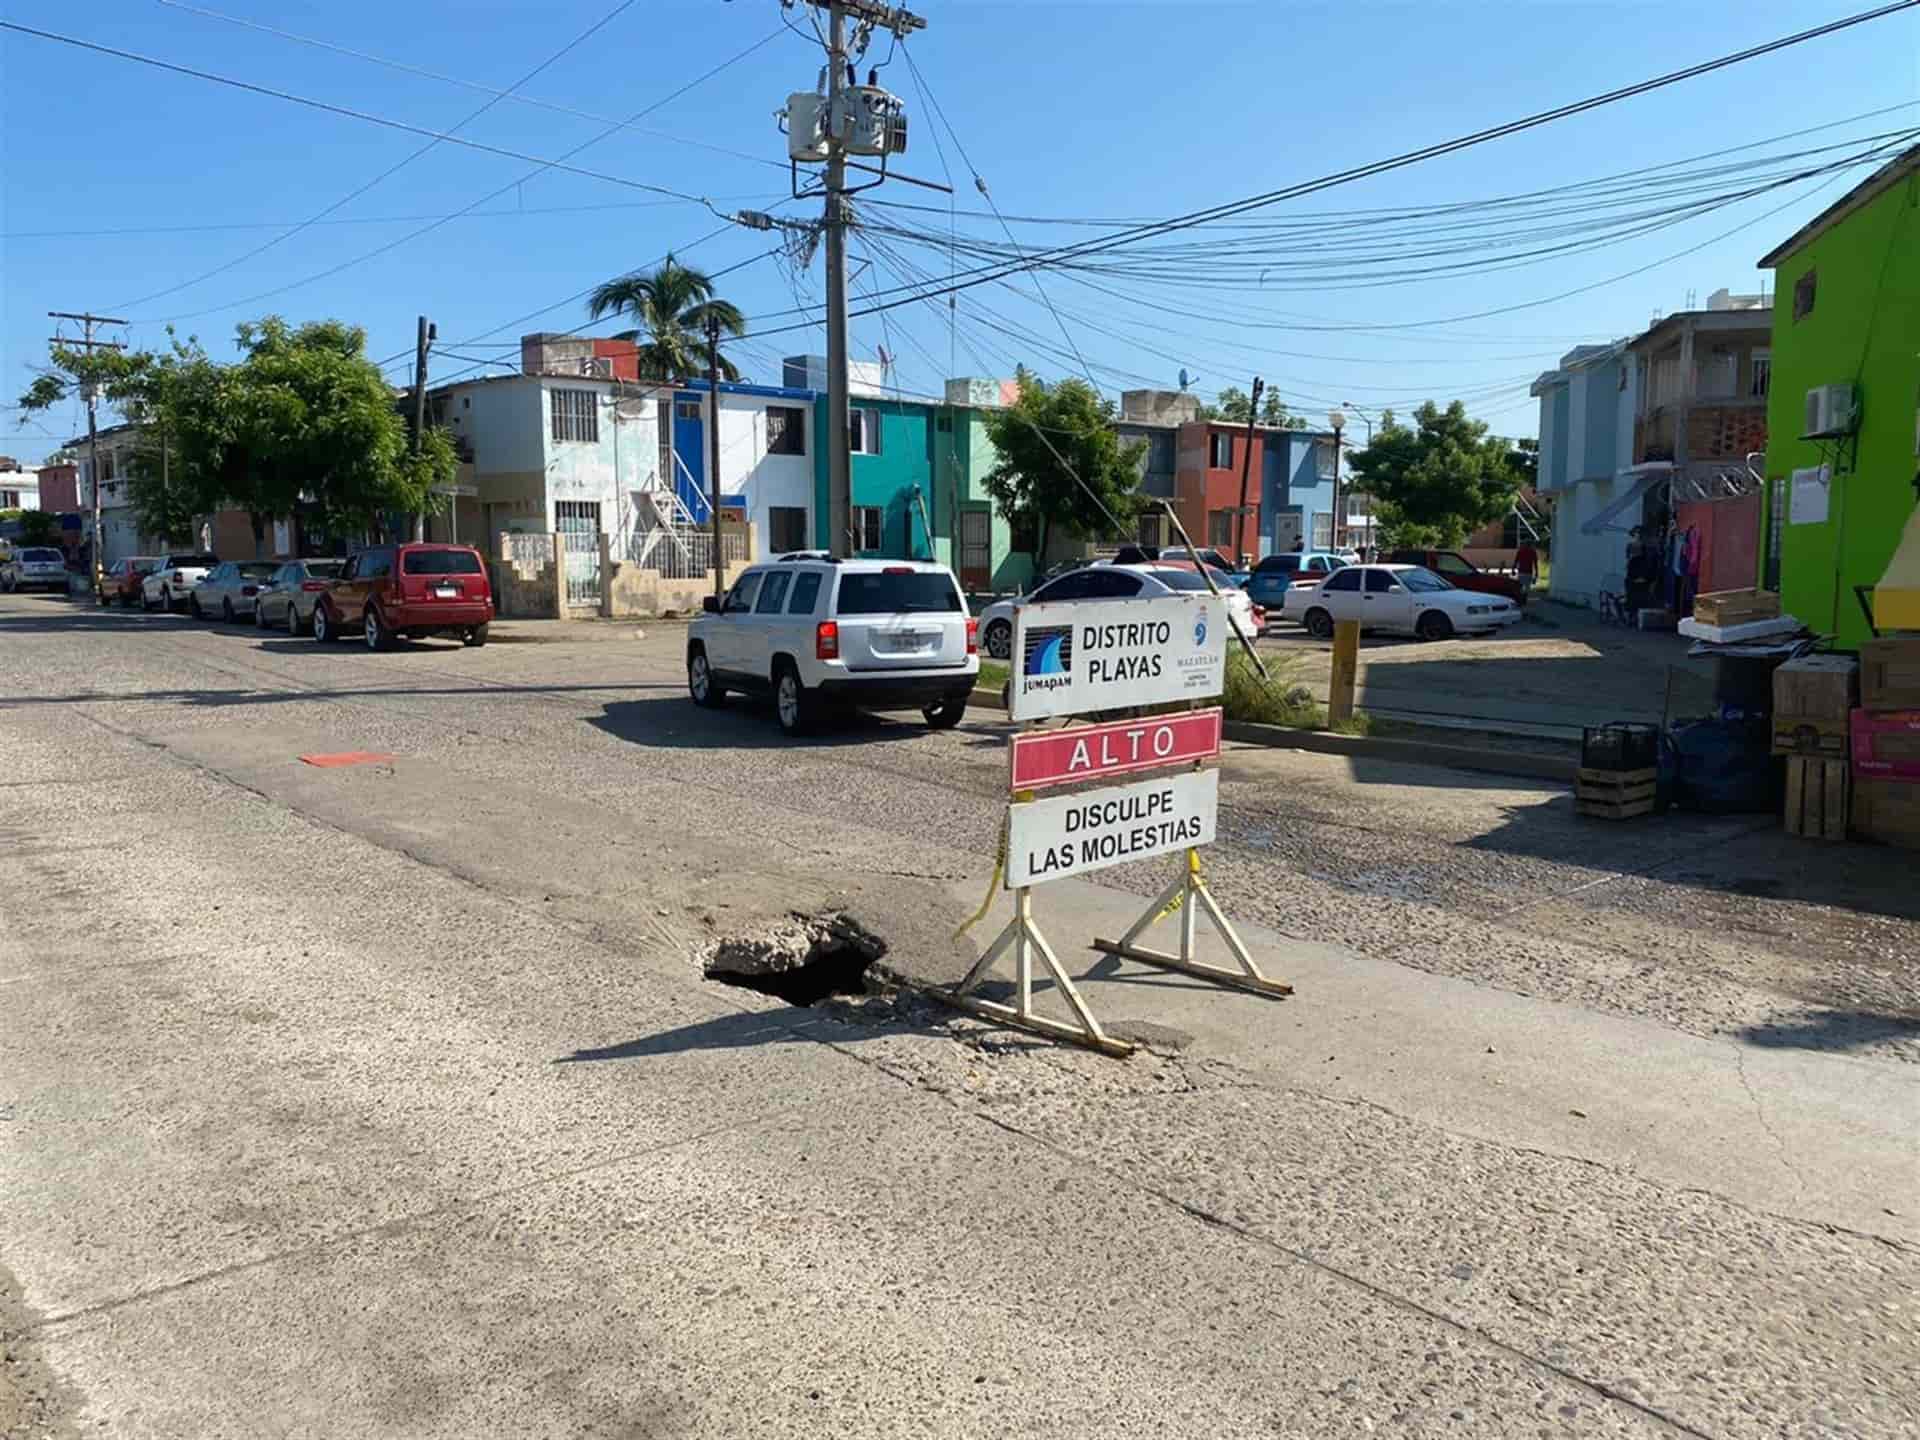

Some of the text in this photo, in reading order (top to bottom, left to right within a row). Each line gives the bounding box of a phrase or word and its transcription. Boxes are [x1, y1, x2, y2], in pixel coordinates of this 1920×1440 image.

[1083, 621, 1170, 650] DISTRITO
[1089, 654, 1161, 683] PLAYAS
[1069, 726, 1174, 771] ALTO
[1065, 790, 1173, 832] DISCULPE
[1029, 816, 1201, 875] LAS MOLESTIAS
